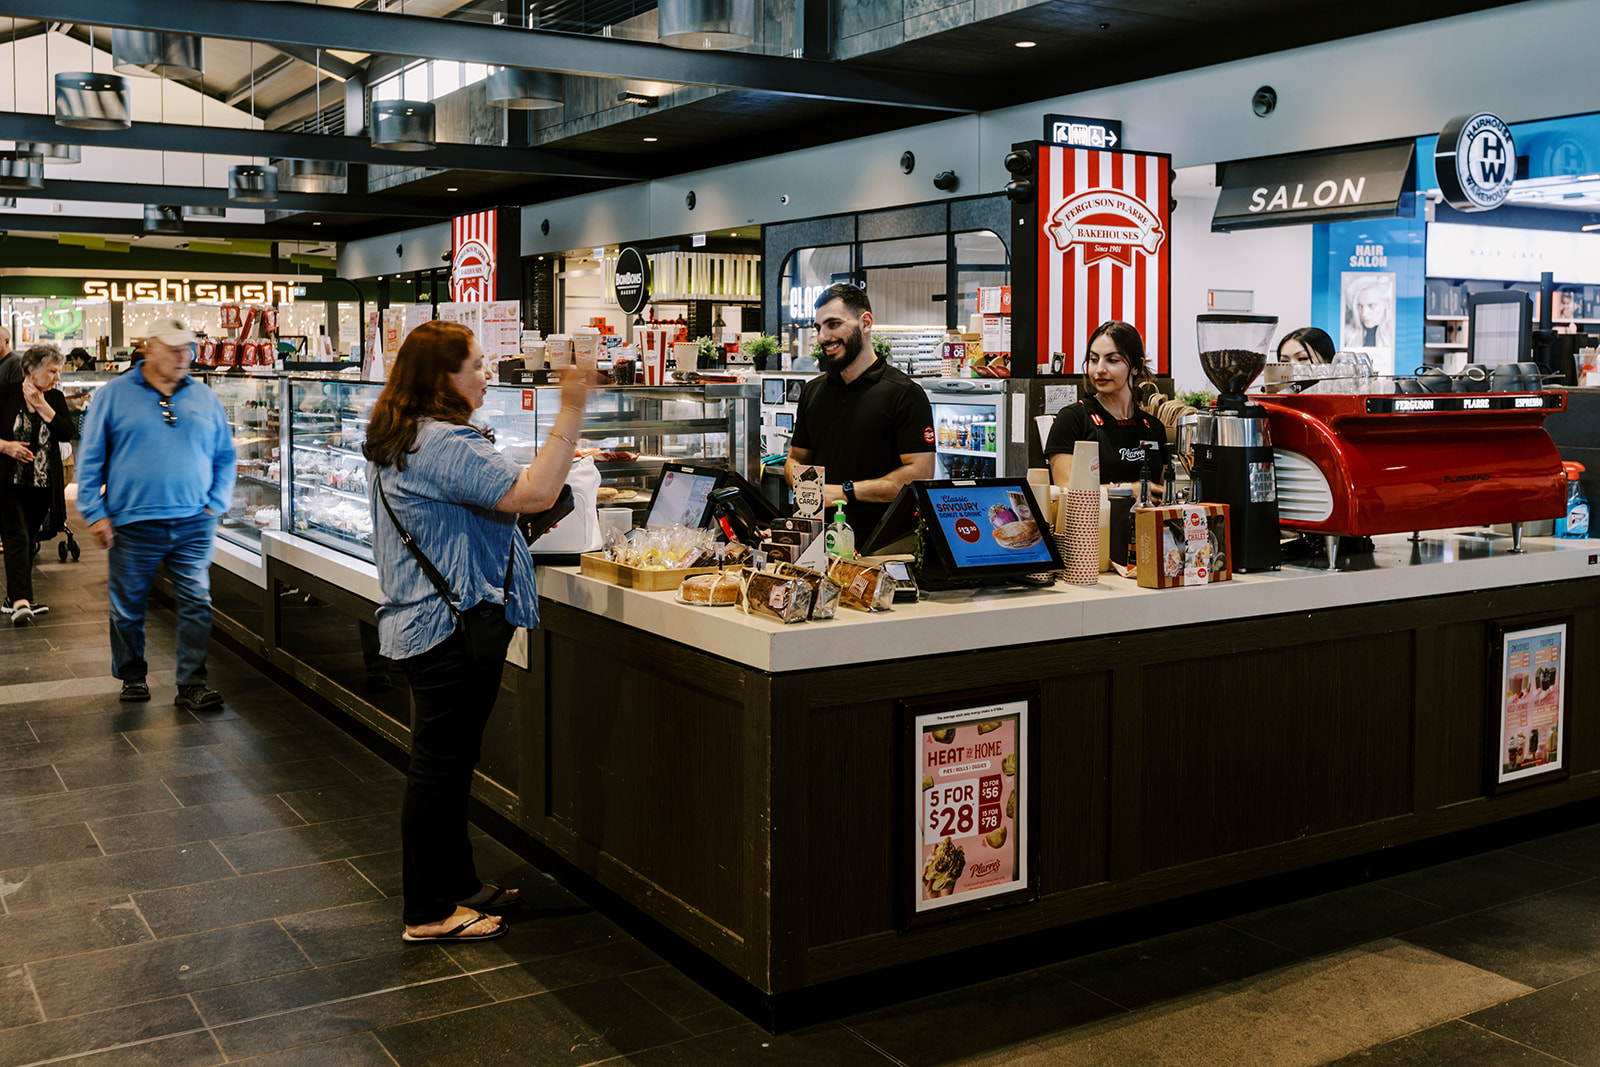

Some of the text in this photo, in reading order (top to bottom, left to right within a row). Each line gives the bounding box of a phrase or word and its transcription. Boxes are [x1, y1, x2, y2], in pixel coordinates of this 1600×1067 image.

[1466, 118, 1512, 144] HAIRHOUSE
[1249, 176, 1366, 212] SALON
[1065, 198, 1149, 226] FERGUSON PLARRE
[1077, 229, 1140, 241] BAKEHOUSES
[1094, 244, 1122, 253] Since 1901
[1355, 245, 1384, 257] HAIR
[1349, 256, 1388, 268] SALON
[1395, 400, 1434, 411] FERGUSON
[1463, 399, 1490, 409] PLARRE
[1514, 398, 1544, 408] ESPRESSO
[801, 491, 816, 499] GIFT
[940, 494, 969, 503] Classic
[798, 498, 819, 506] CARDS
[936, 502, 979, 513] SAVOURY
[1187, 533, 1206, 542] CHALET
[928, 747, 964, 767] HEAT
[974, 740, 1003, 760] HOME
[971, 762, 987, 770] OGGIES
[989, 779, 1000, 787] FOR
[929, 785, 974, 807] 5 FOR
[981, 787, 999, 799] $56
[982, 810, 988, 818] 15
[981, 816, 998, 829] $78
[969, 858, 1001, 879] Plarre's
